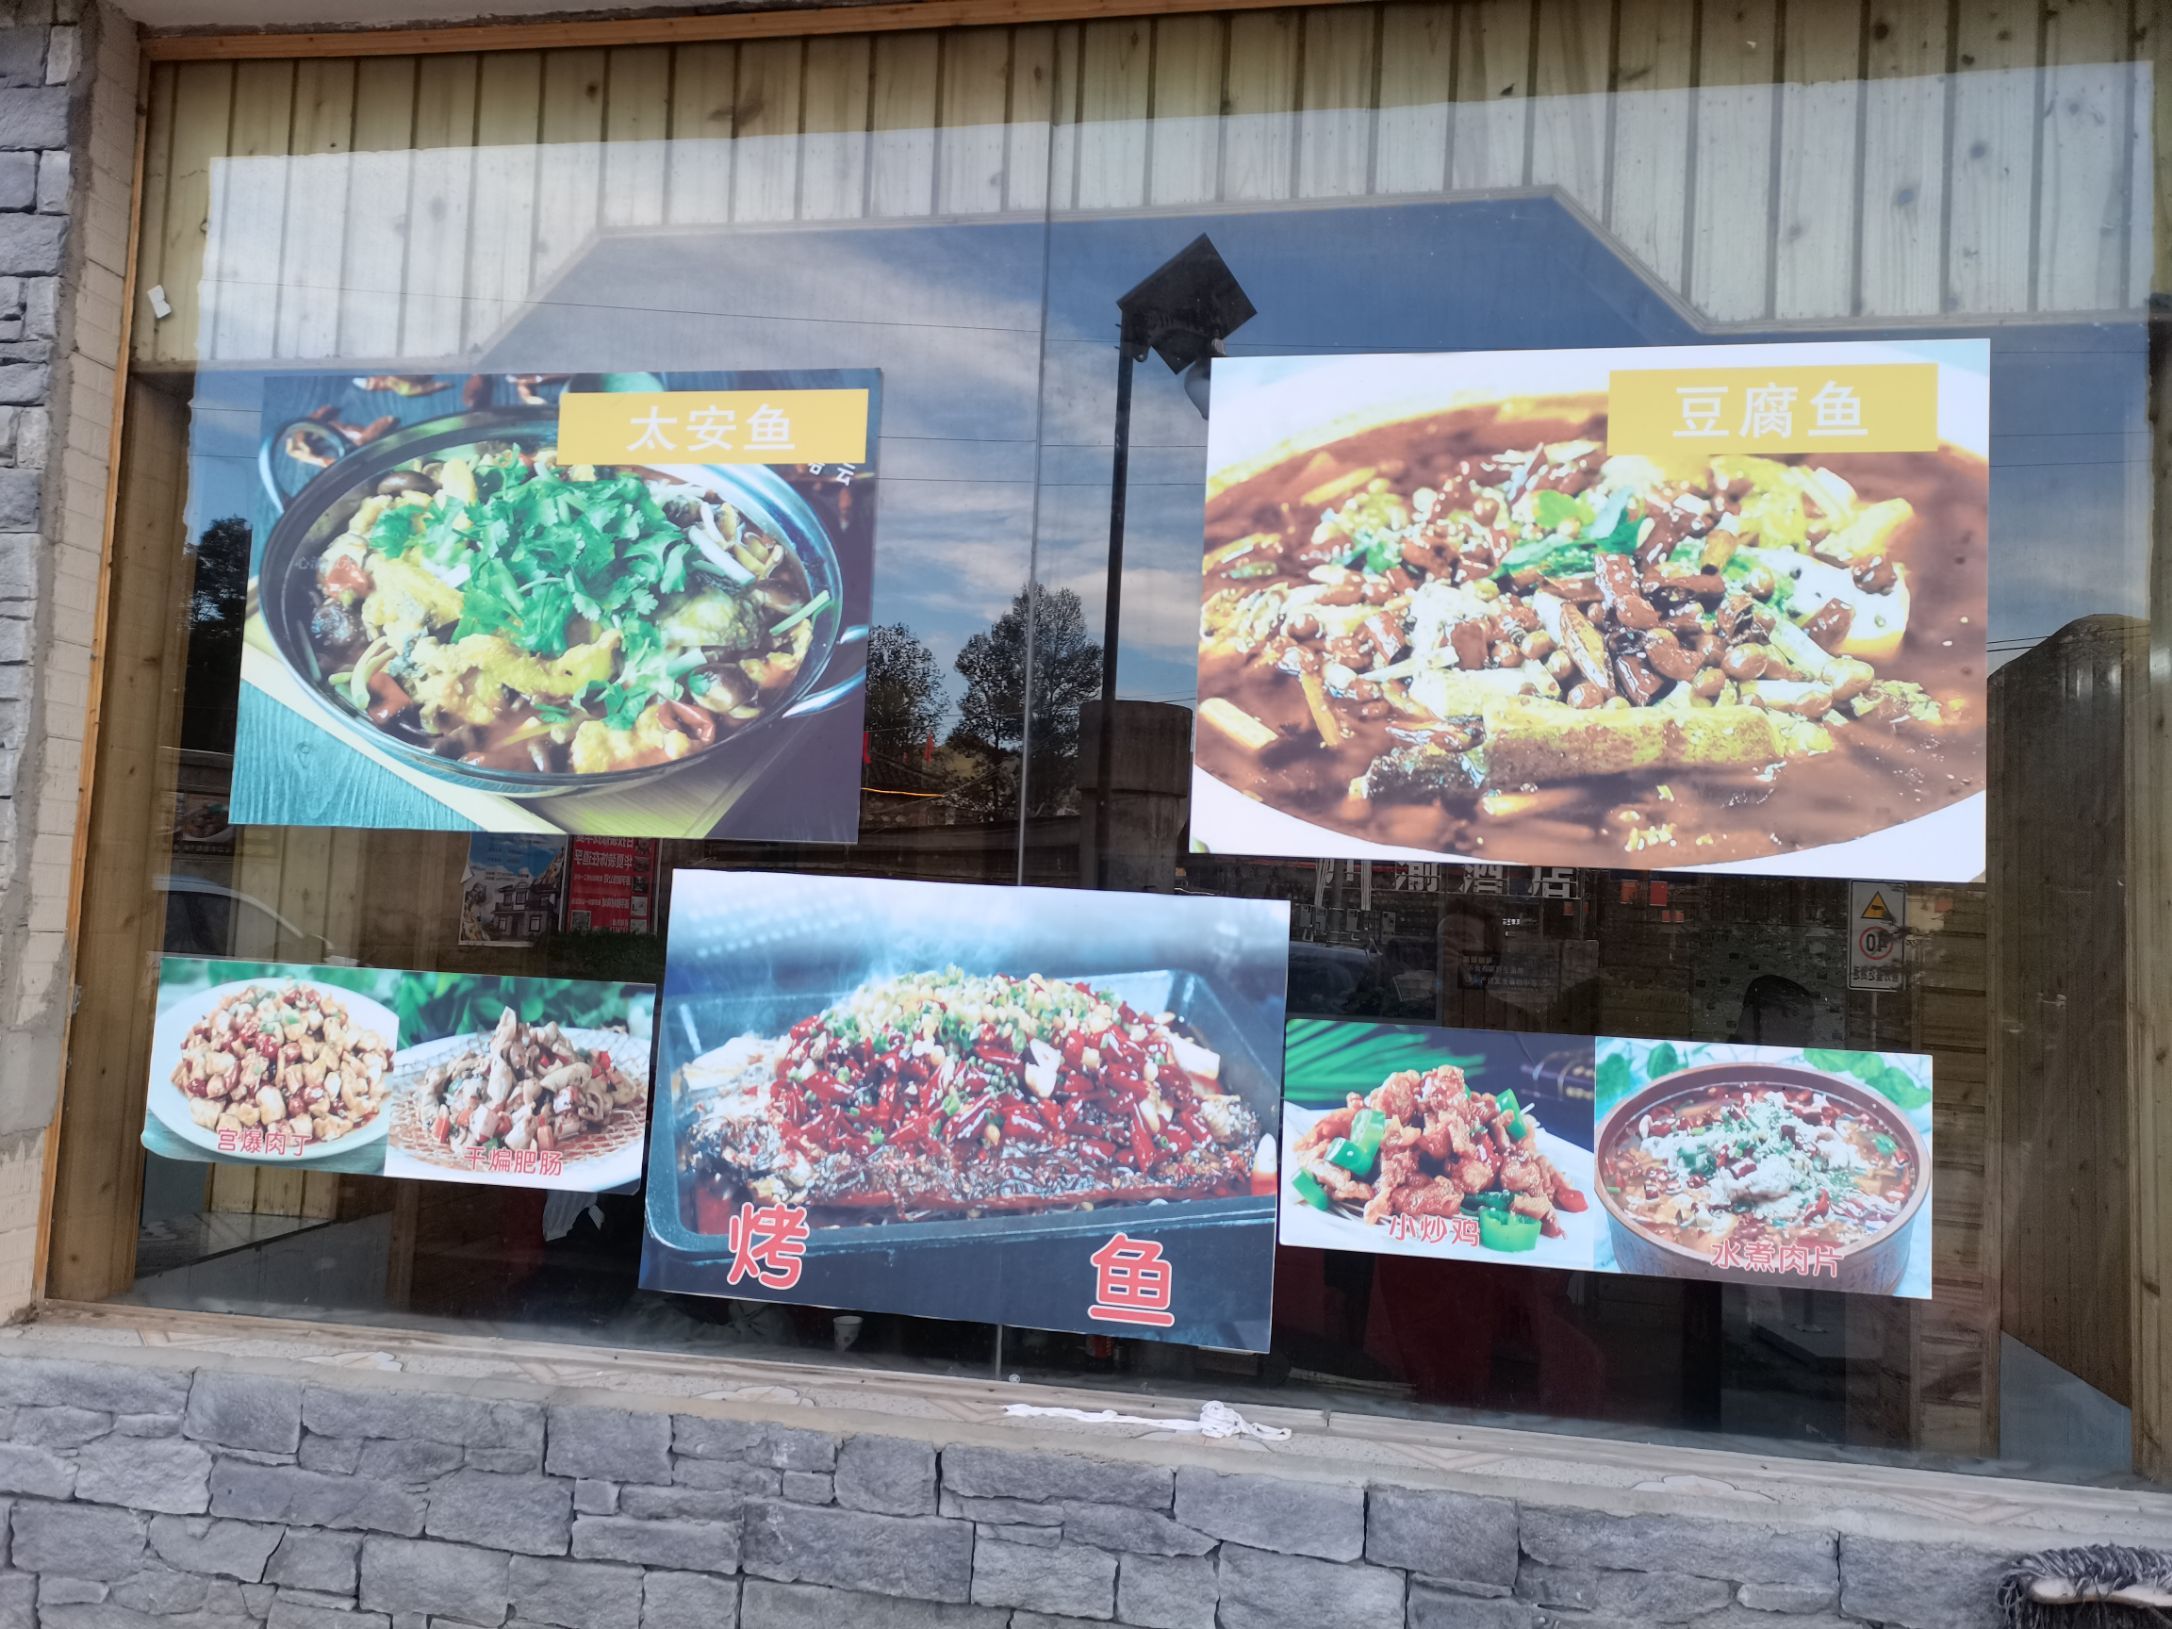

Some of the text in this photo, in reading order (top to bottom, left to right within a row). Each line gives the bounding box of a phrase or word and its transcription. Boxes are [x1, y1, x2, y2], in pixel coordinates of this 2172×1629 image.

[626, 404, 795, 451] 太安鱼
[1673, 380, 1868, 438] 豆腐鱼
[217, 1127, 317, 1157] 宫爆肉丁
[463, 1144, 563, 1177] 干煸肥肠
[1388, 1212, 1480, 1248] 小炒鸡
[727, 1201, 1176, 1327] 烤 鱼
[1711, 1238, 1844, 1278] 水煮肉片
